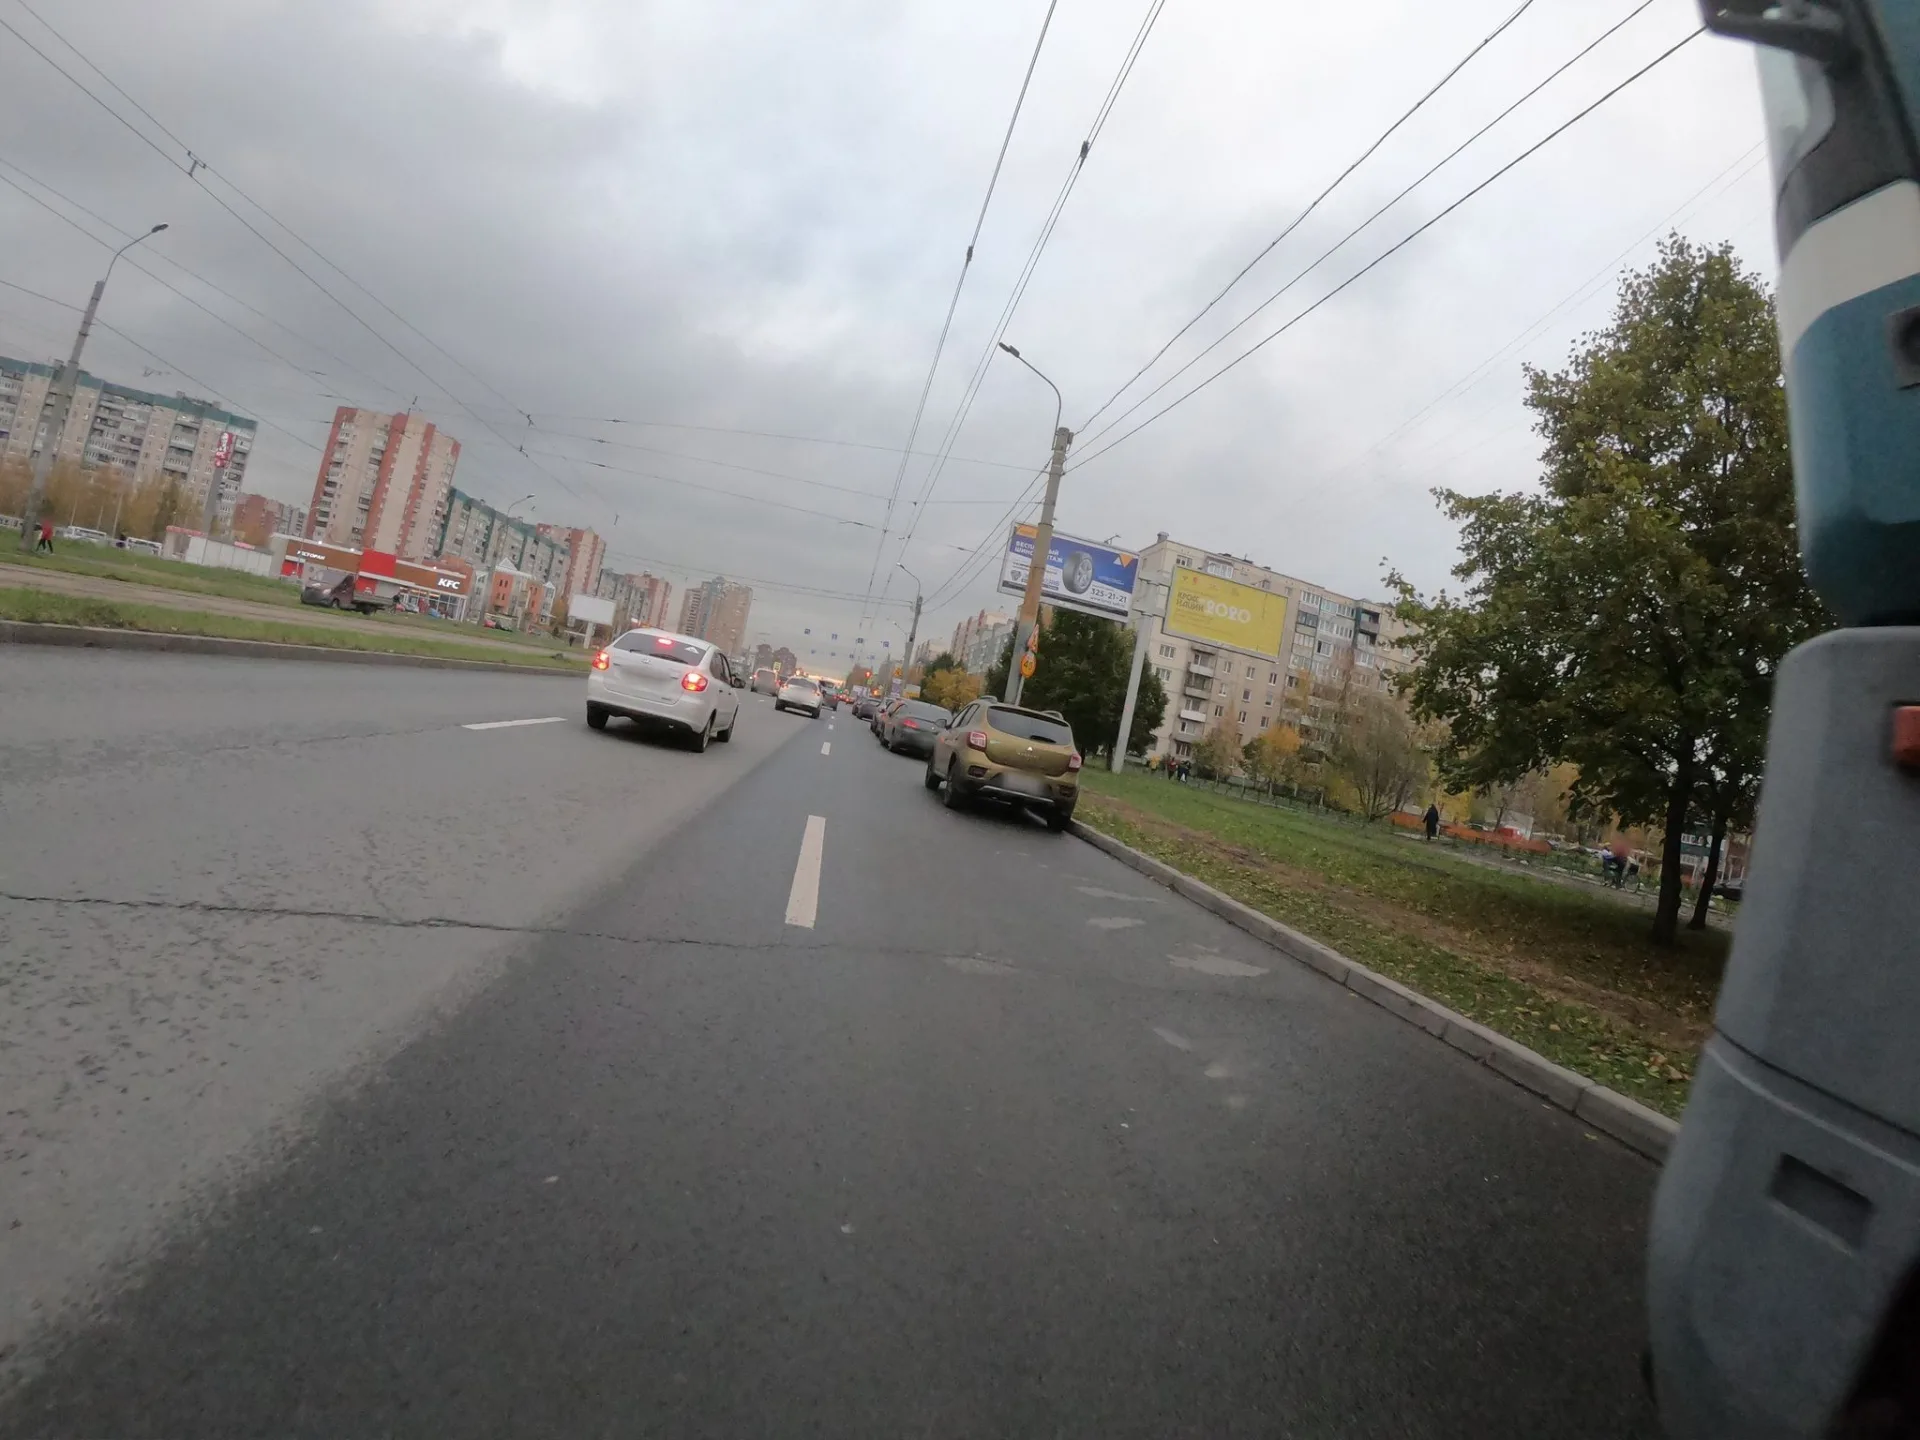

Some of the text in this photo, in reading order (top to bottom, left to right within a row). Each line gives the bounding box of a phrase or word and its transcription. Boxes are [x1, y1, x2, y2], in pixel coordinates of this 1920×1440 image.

[437, 577, 461, 590] KFC
[1090, 587, 1127, 603] 325-21-21
[1206, 599, 1251, 624] 2020
